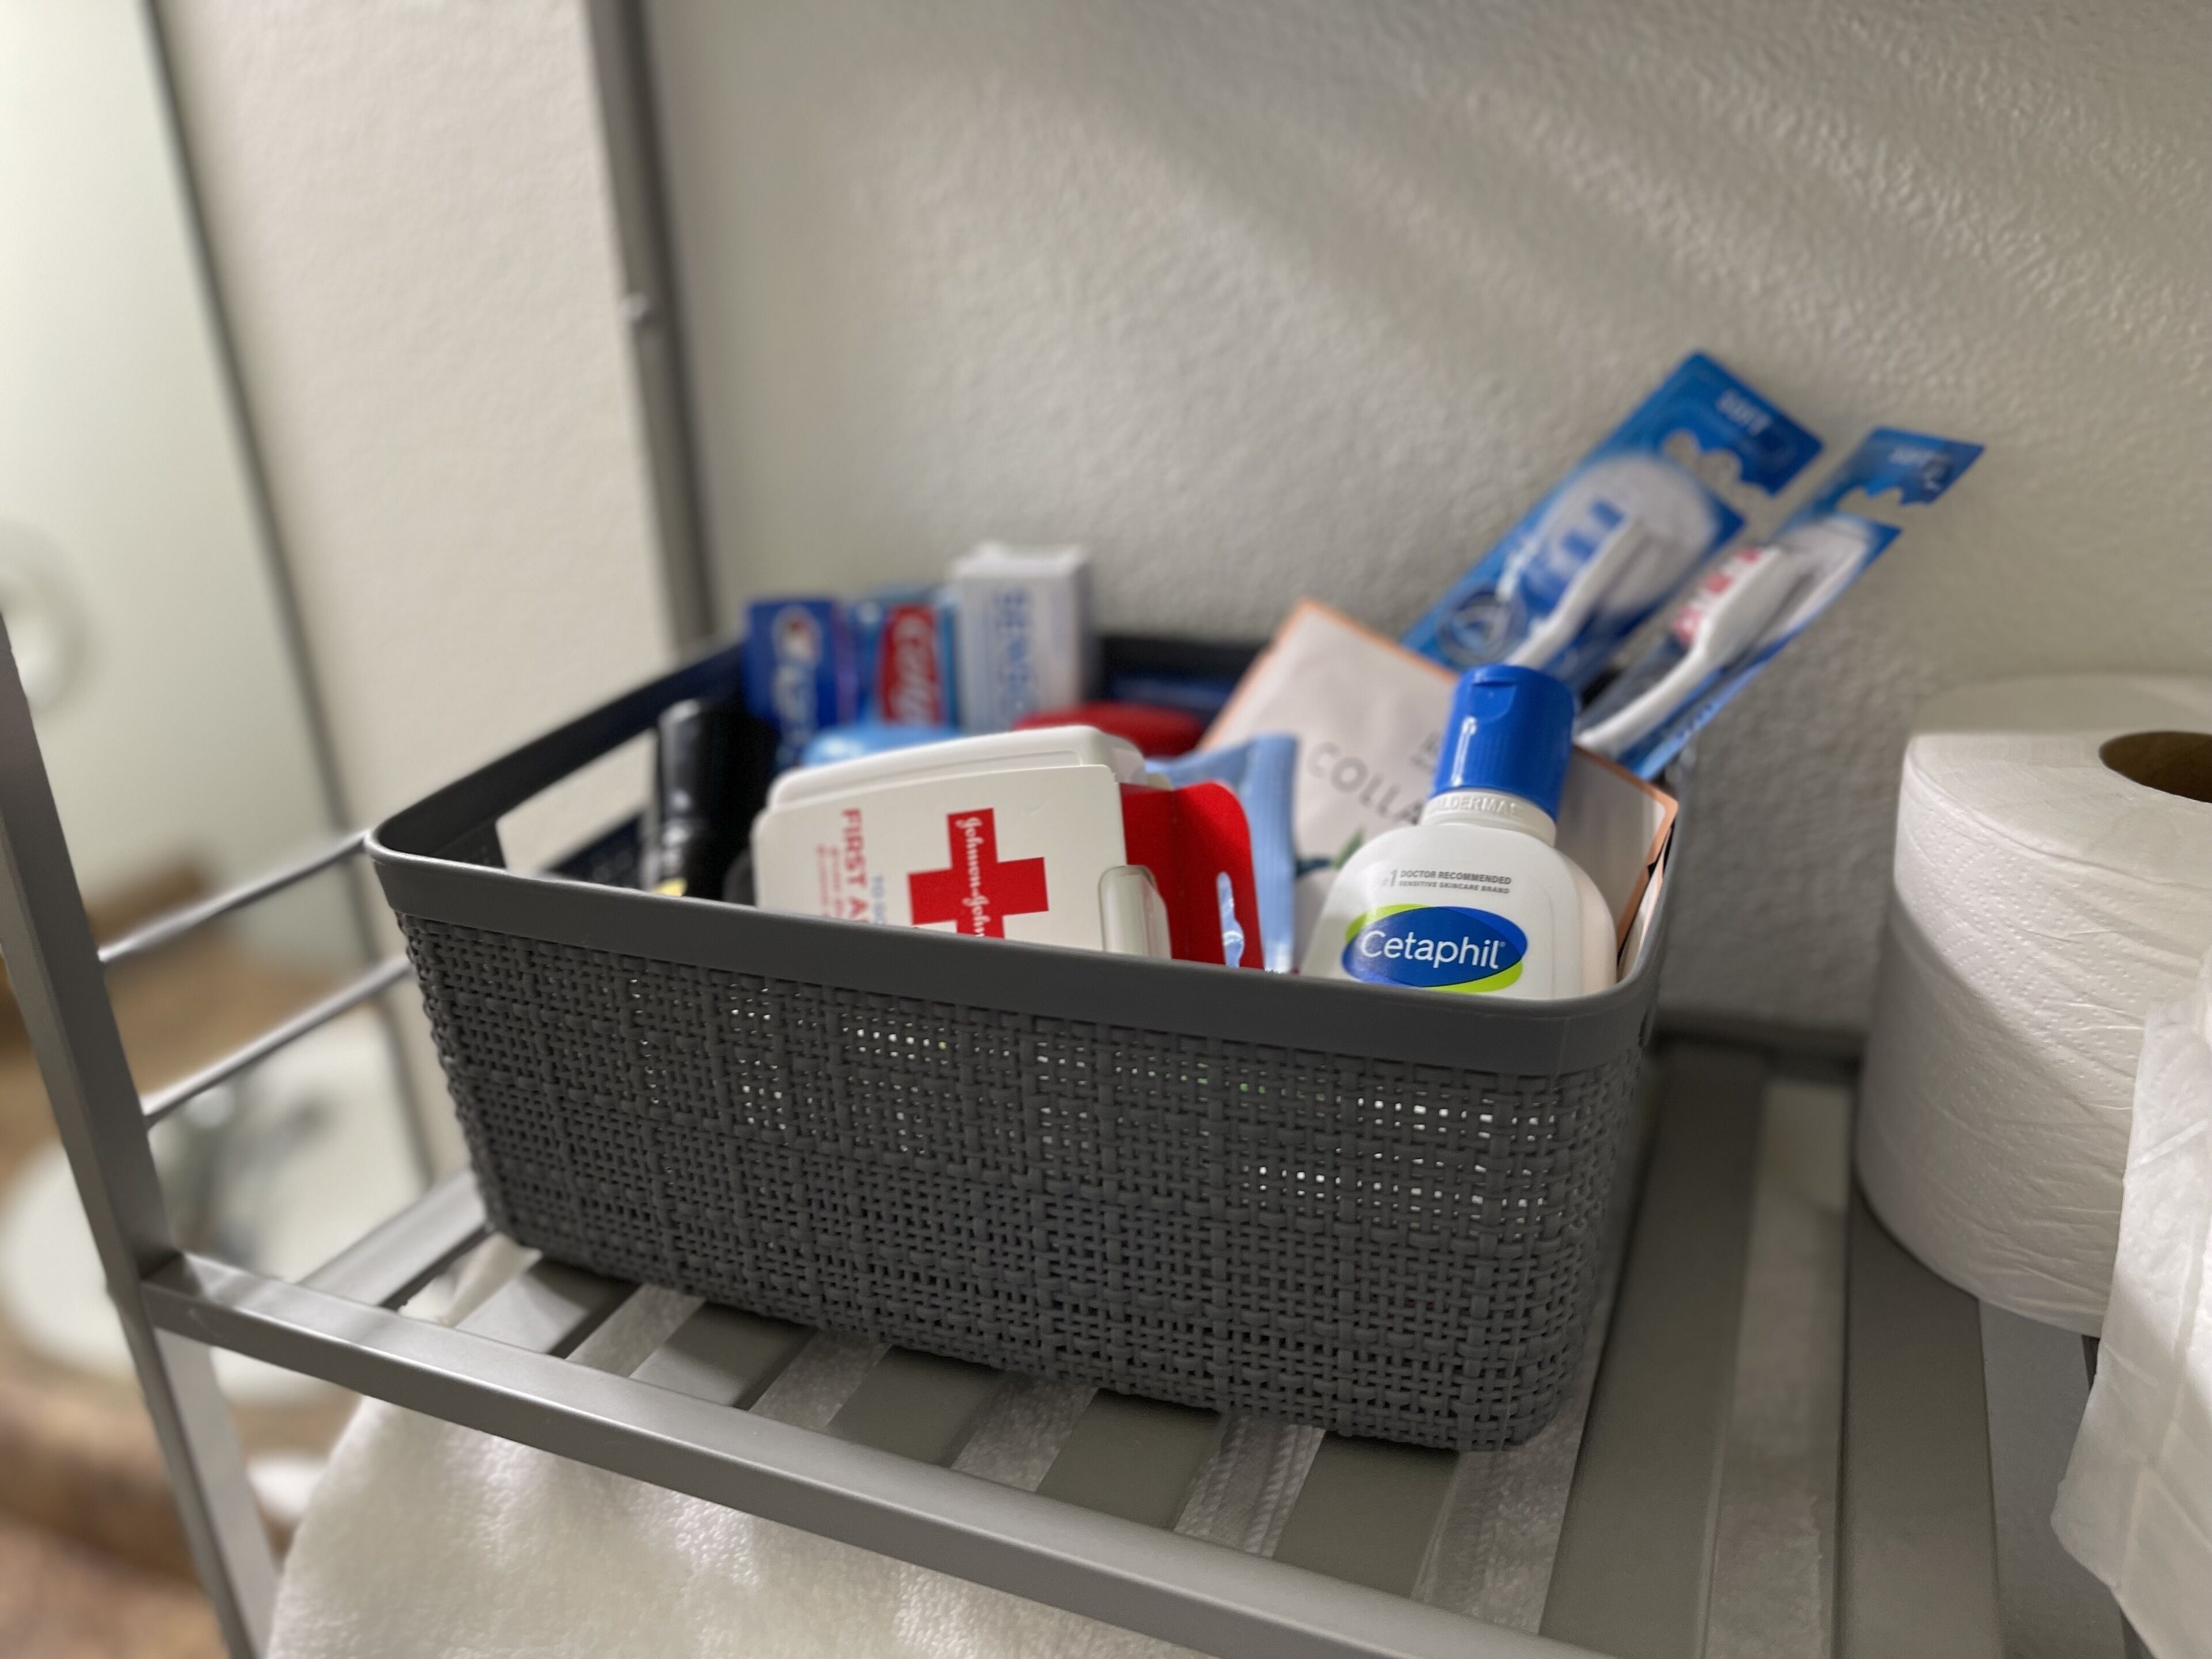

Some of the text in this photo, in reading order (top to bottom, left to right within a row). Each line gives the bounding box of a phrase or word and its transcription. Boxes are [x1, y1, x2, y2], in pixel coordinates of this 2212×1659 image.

[842, 808, 868, 888] FIRST
[1400, 870, 1512, 885] DOCTOR RECOMMENDED
[1439, 882, 1479, 891] SKINCARE
[1481, 885, 1510, 894] BRAND
[1361, 930, 1500, 969] Cetaphil
